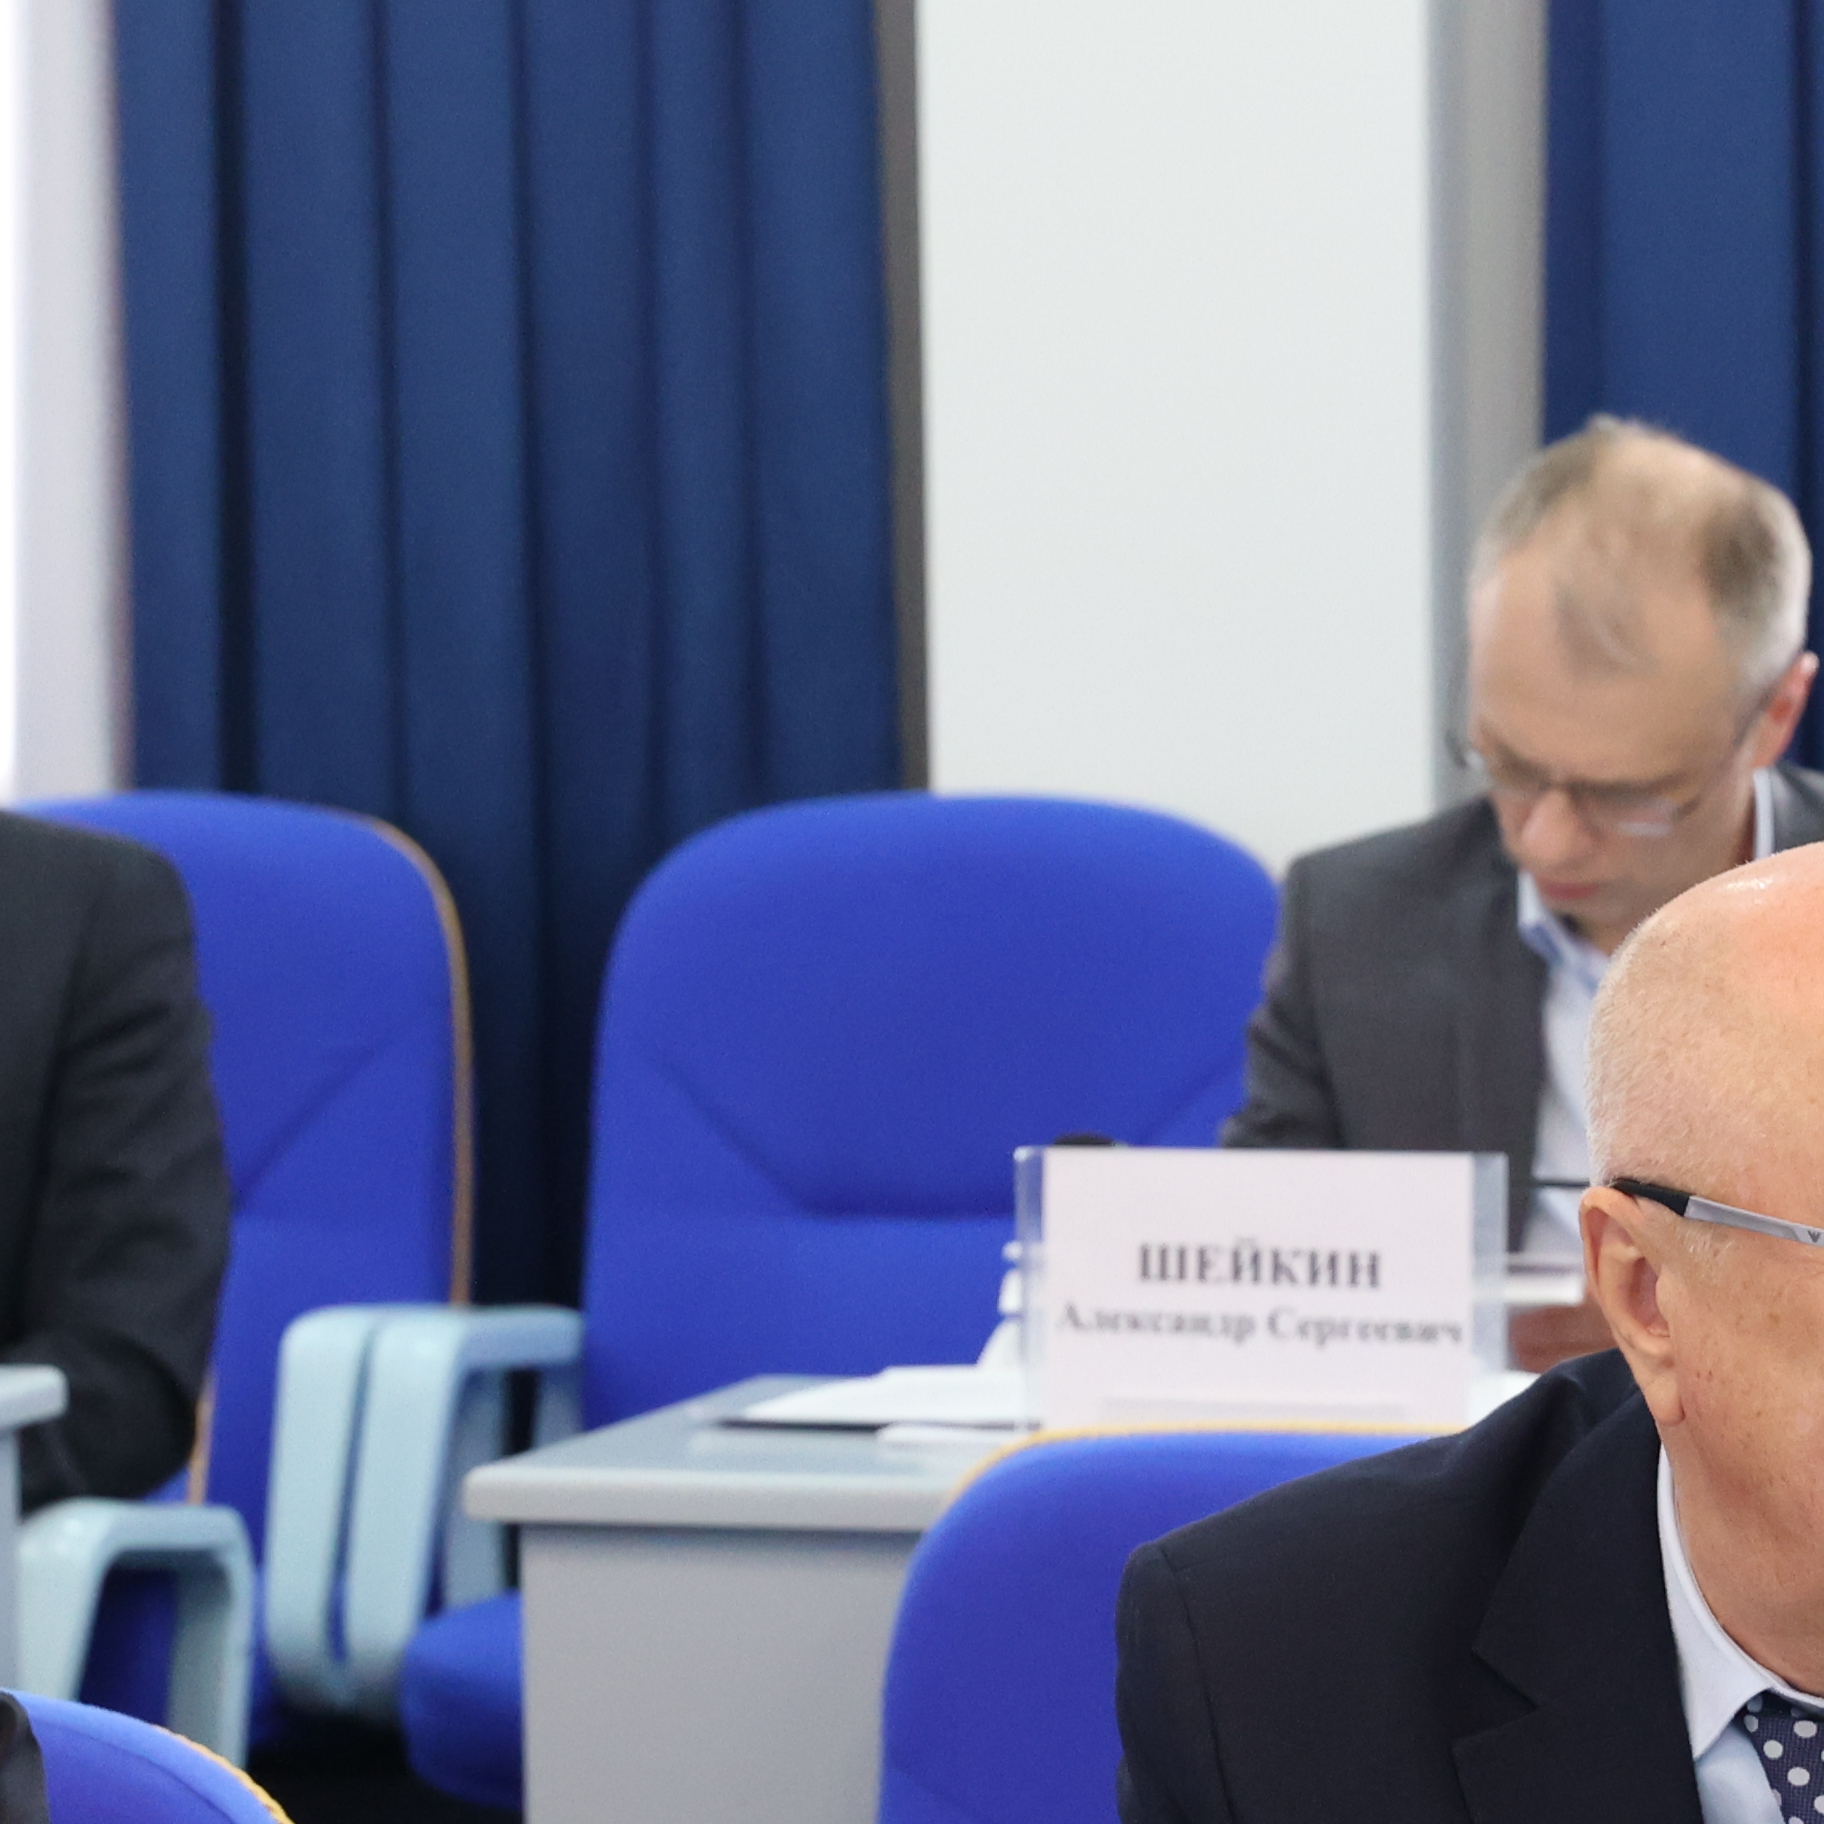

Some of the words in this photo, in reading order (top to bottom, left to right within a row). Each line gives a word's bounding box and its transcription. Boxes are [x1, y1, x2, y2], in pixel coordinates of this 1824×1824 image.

[1138, 1238, 1381, 1289] ШЕЙКИН
[1058, 1303, 1256, 1344] Александр
[1266, 1307, 1462, 1348] Сергеевич
